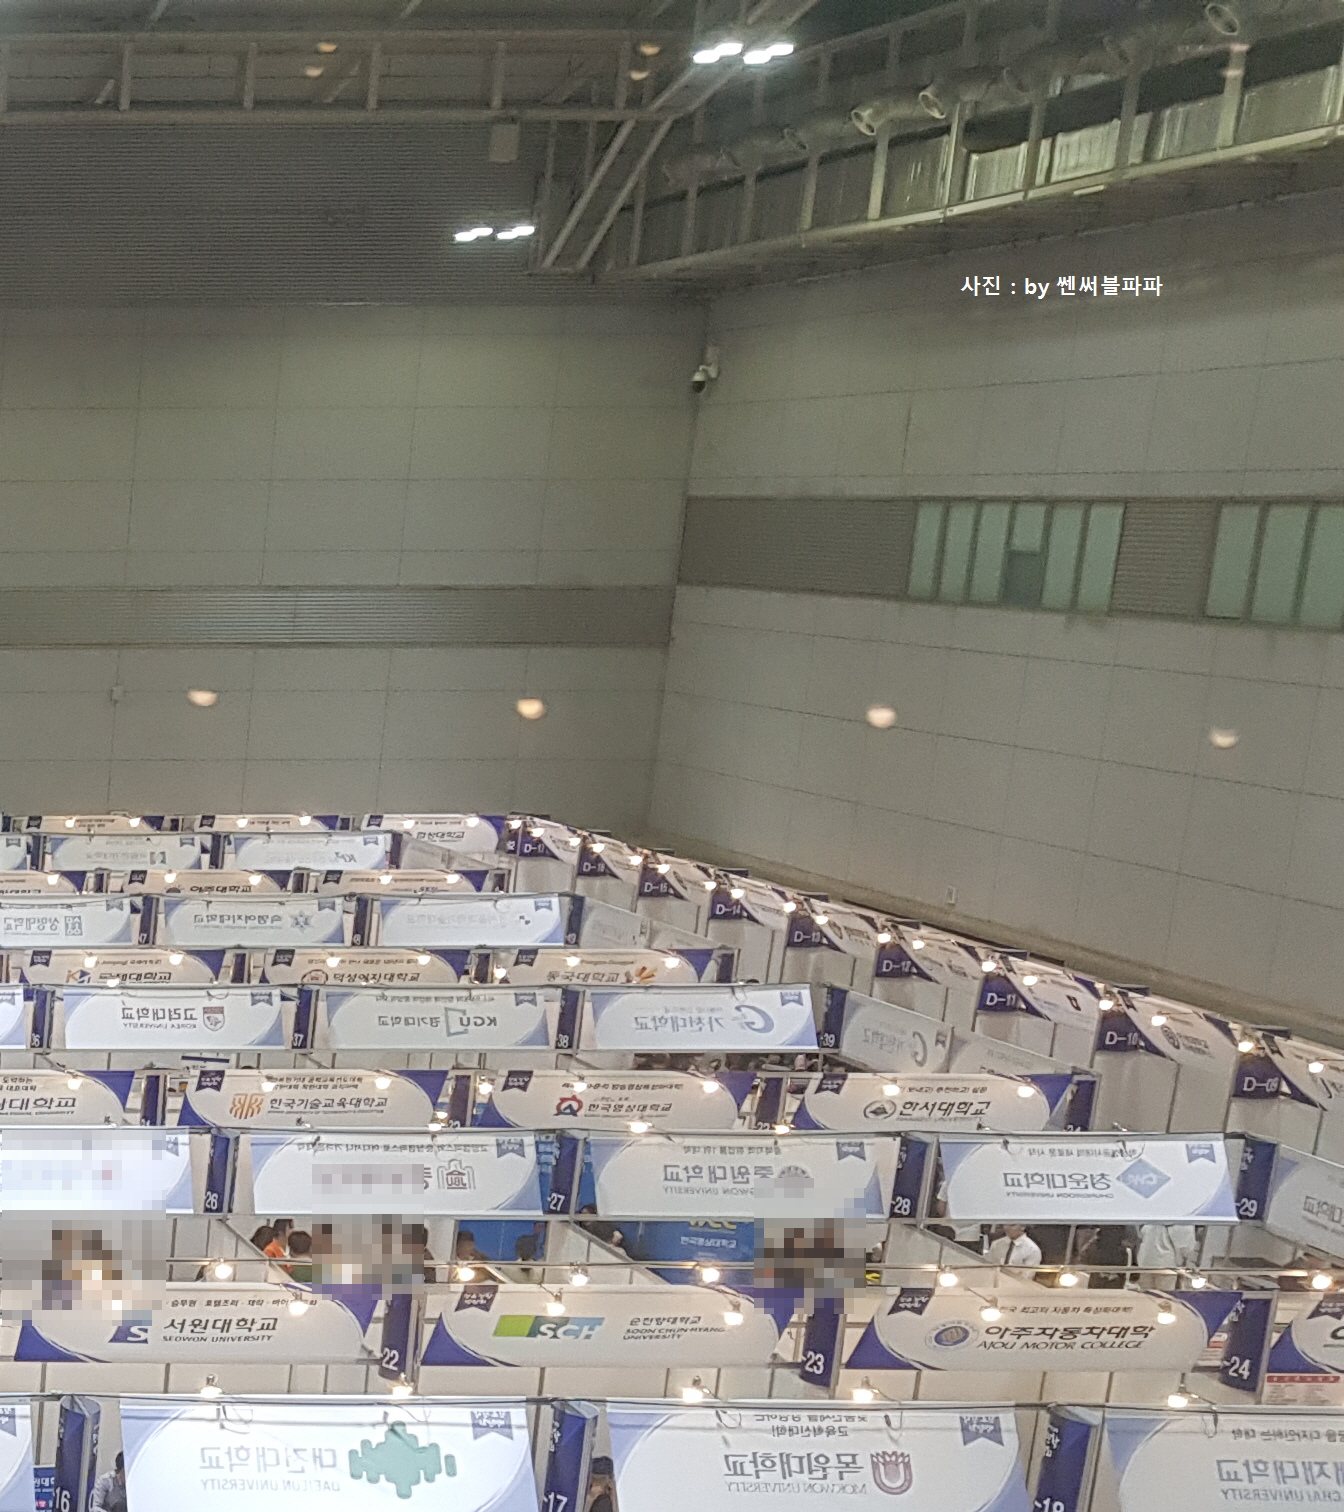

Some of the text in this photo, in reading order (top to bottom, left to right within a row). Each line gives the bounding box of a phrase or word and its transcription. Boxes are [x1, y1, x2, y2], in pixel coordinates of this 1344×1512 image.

[332, 970, 421, 984] 덕성여자대학교
[1104, 1030, 1139, 1047] D-10
[1242, 1075, 1280, 1093] D-09
[269, 1095, 388, 1110] 한국기술교육대학교
[587, 1102, 673, 1115] 한국영상대학교
[899, 1100, 992, 1118] 한서대학교
[163, 1316, 278, 1334] 서원대학교
[536, 1315, 606, 1341] SCH
[629, 1315, 703, 1327] 순천향대학교
[162, 1334, 274, 1344] SEOWON UNIVERSITY
[984, 1324, 1157, 1341] 아주자동차대학
[977, 1338, 1145, 1351] AJOU MOTOR COLLEGE
